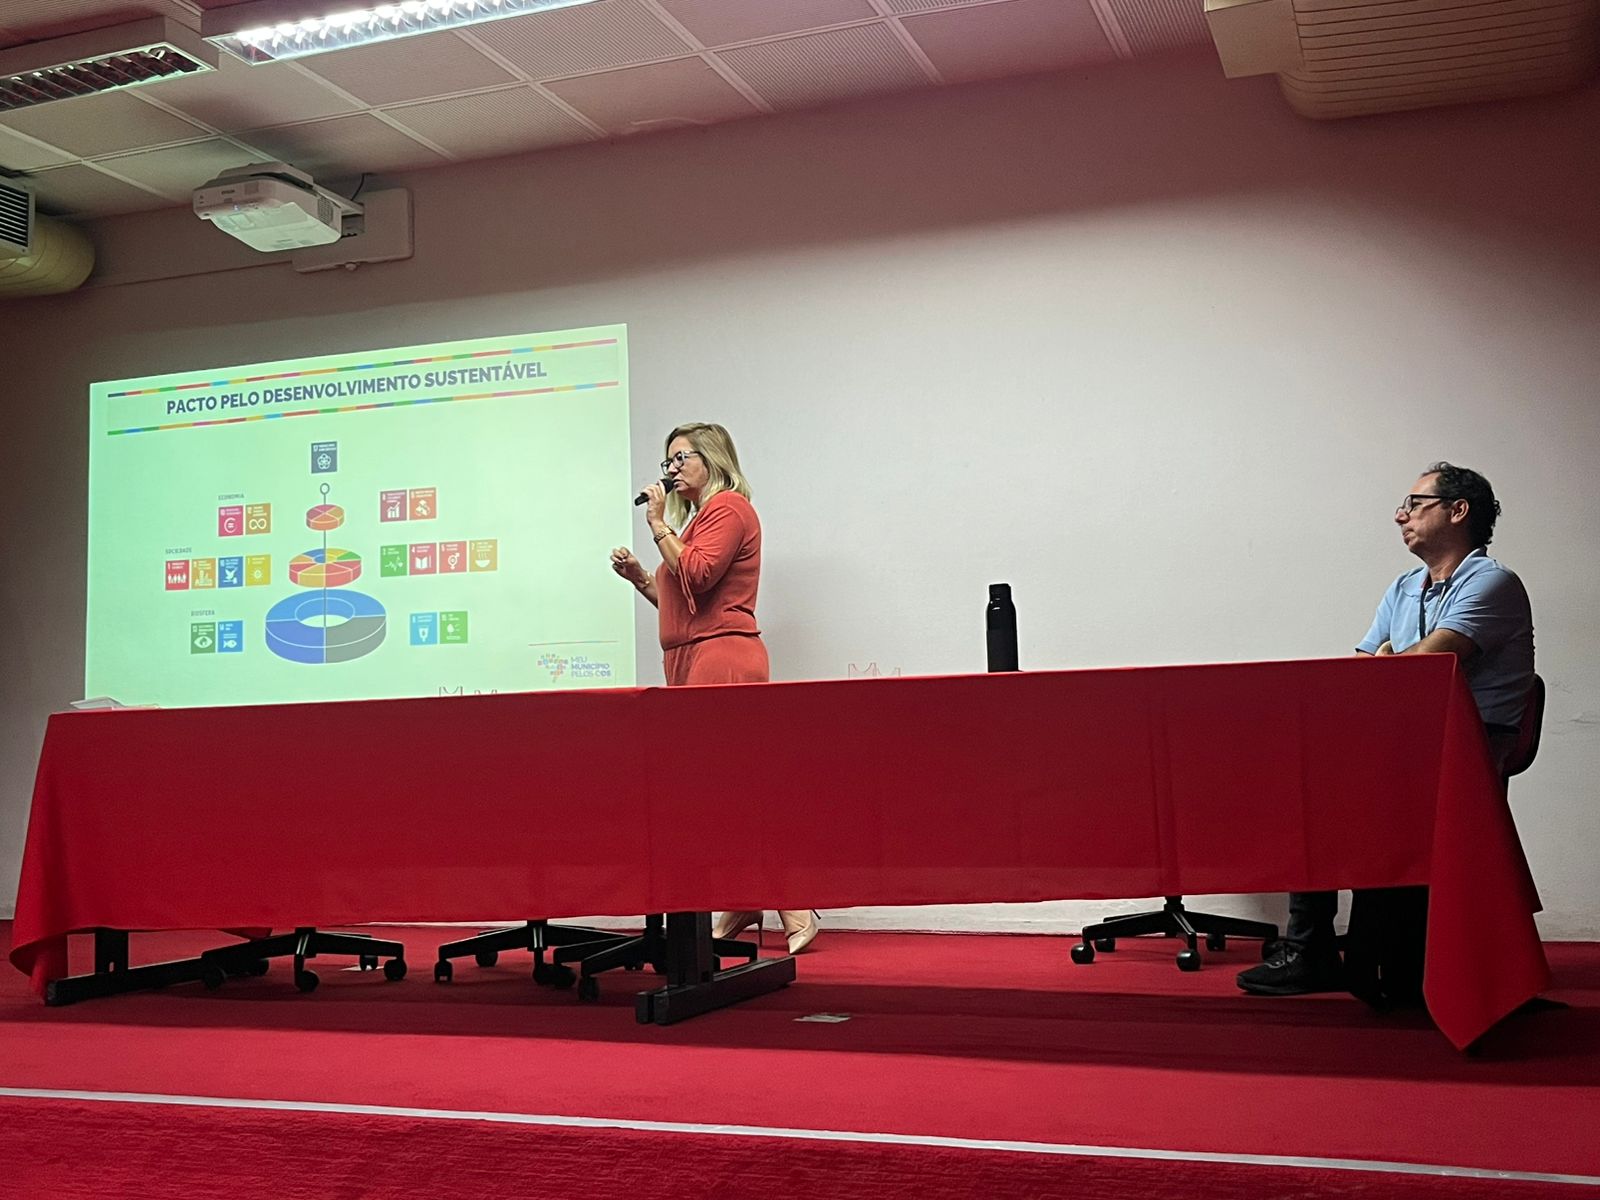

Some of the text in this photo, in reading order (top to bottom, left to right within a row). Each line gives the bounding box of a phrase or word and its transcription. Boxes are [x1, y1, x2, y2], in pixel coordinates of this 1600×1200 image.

[167, 361, 547, 415] PACTO PELO DESENVOLVIMENTO SUSTENTÁVEL
